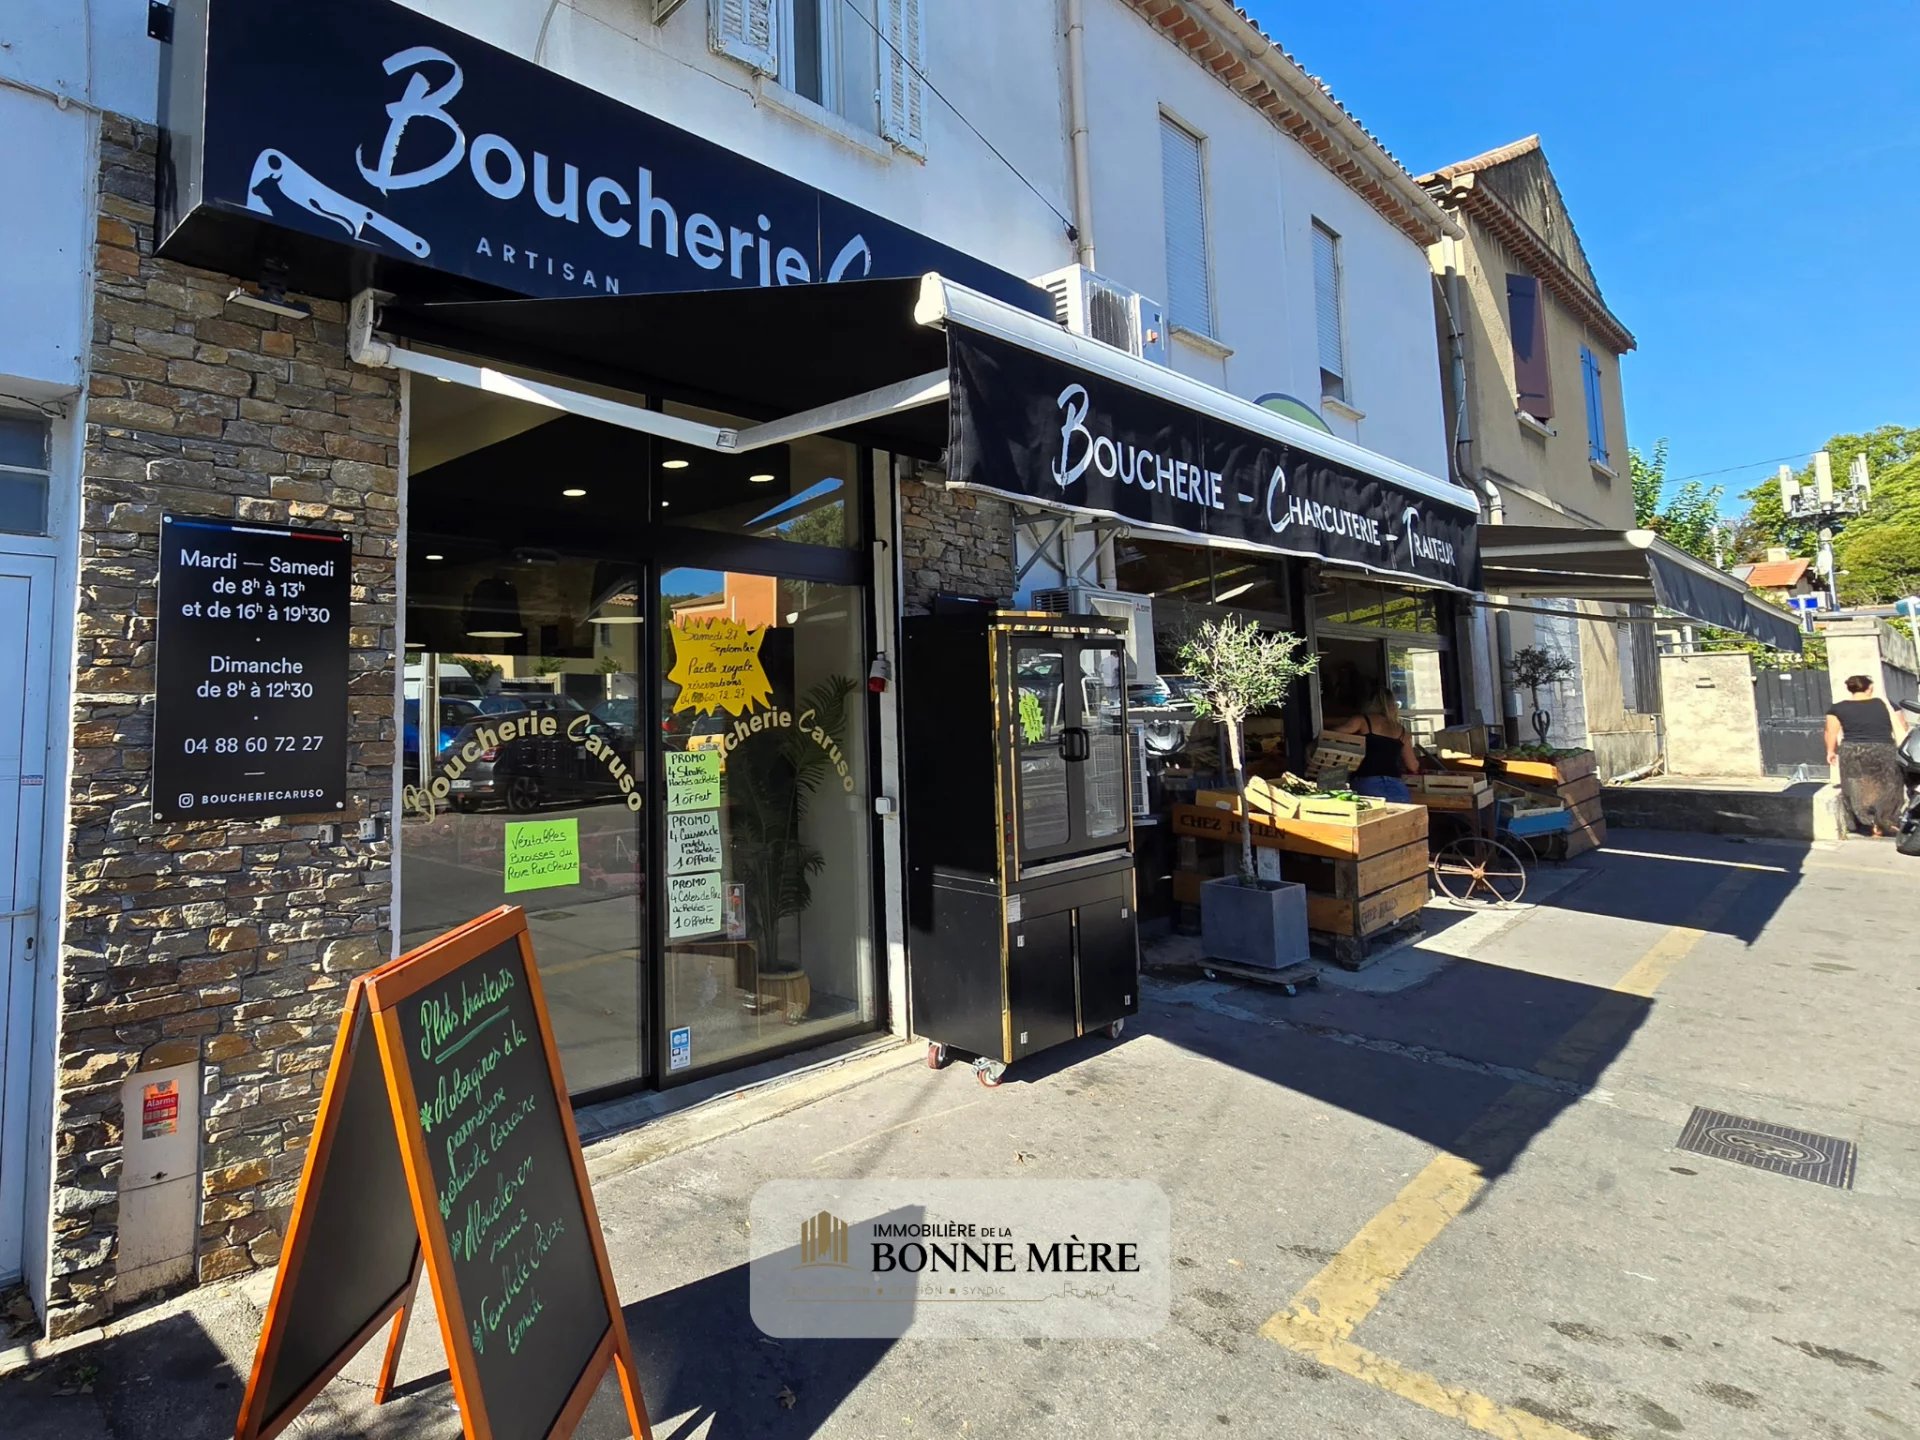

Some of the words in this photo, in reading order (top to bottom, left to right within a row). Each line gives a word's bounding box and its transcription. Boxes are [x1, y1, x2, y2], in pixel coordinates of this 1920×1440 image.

[355, 46, 812, 288] Boucherie
[475, 235, 622, 296] ARTISAN
[180, 549, 238, 570] Mardi
[269, 556, 335, 578] Samedi
[212, 576, 236, 595] de
[241, 577, 261, 596] 8h
[264, 580, 276, 597] à
[280, 581, 305, 599] 13h
[181, 602, 202, 617] et
[206, 601, 232, 619] de
[236, 602, 263, 620] 16h
[267, 604, 279, 621] à
[283, 605, 331, 623] 19h30
[680, 627, 723, 642] Samedi
[725, 628, 739, 641] 27
[209, 655, 304, 674] Dimanche
[196, 680, 222, 698] de
[226, 681, 246, 698] 8h
[250, 681, 262, 698] à
[266, 681, 314, 698] 12h30
[184, 738, 209, 754] 04
[215, 737, 239, 753] 88
[244, 736, 268, 753] 60
[274, 736, 296, 752] 72
[302, 735, 324, 751] 27
[799, 708, 855, 792] Caruso
[402, 710, 558, 825] Boucherie
[567, 713, 643, 813] Caruso
[671, 753, 706, 765] PROMO
[668, 766, 676, 778] 4
[201, 788, 325, 805] BOUCHERIECARUSO
[671, 793, 681, 807] 1
[671, 814, 711, 829] PROMO
[1180, 813, 1221, 831] CHEZ
[669, 830, 678, 843] 4
[558, 848, 574, 858] du
[673, 856, 683, 870] 1
[672, 878, 707, 891] PROMO
[670, 892, 677, 904] 4
[674, 915, 682, 929] 1
[420, 991, 459, 1060] Plats
[461, 968, 515, 1026] traiteurs
[504, 1031, 513, 1056] à
[511, 1019, 528, 1047] la
[146, 1096, 176, 1108] Alarme
